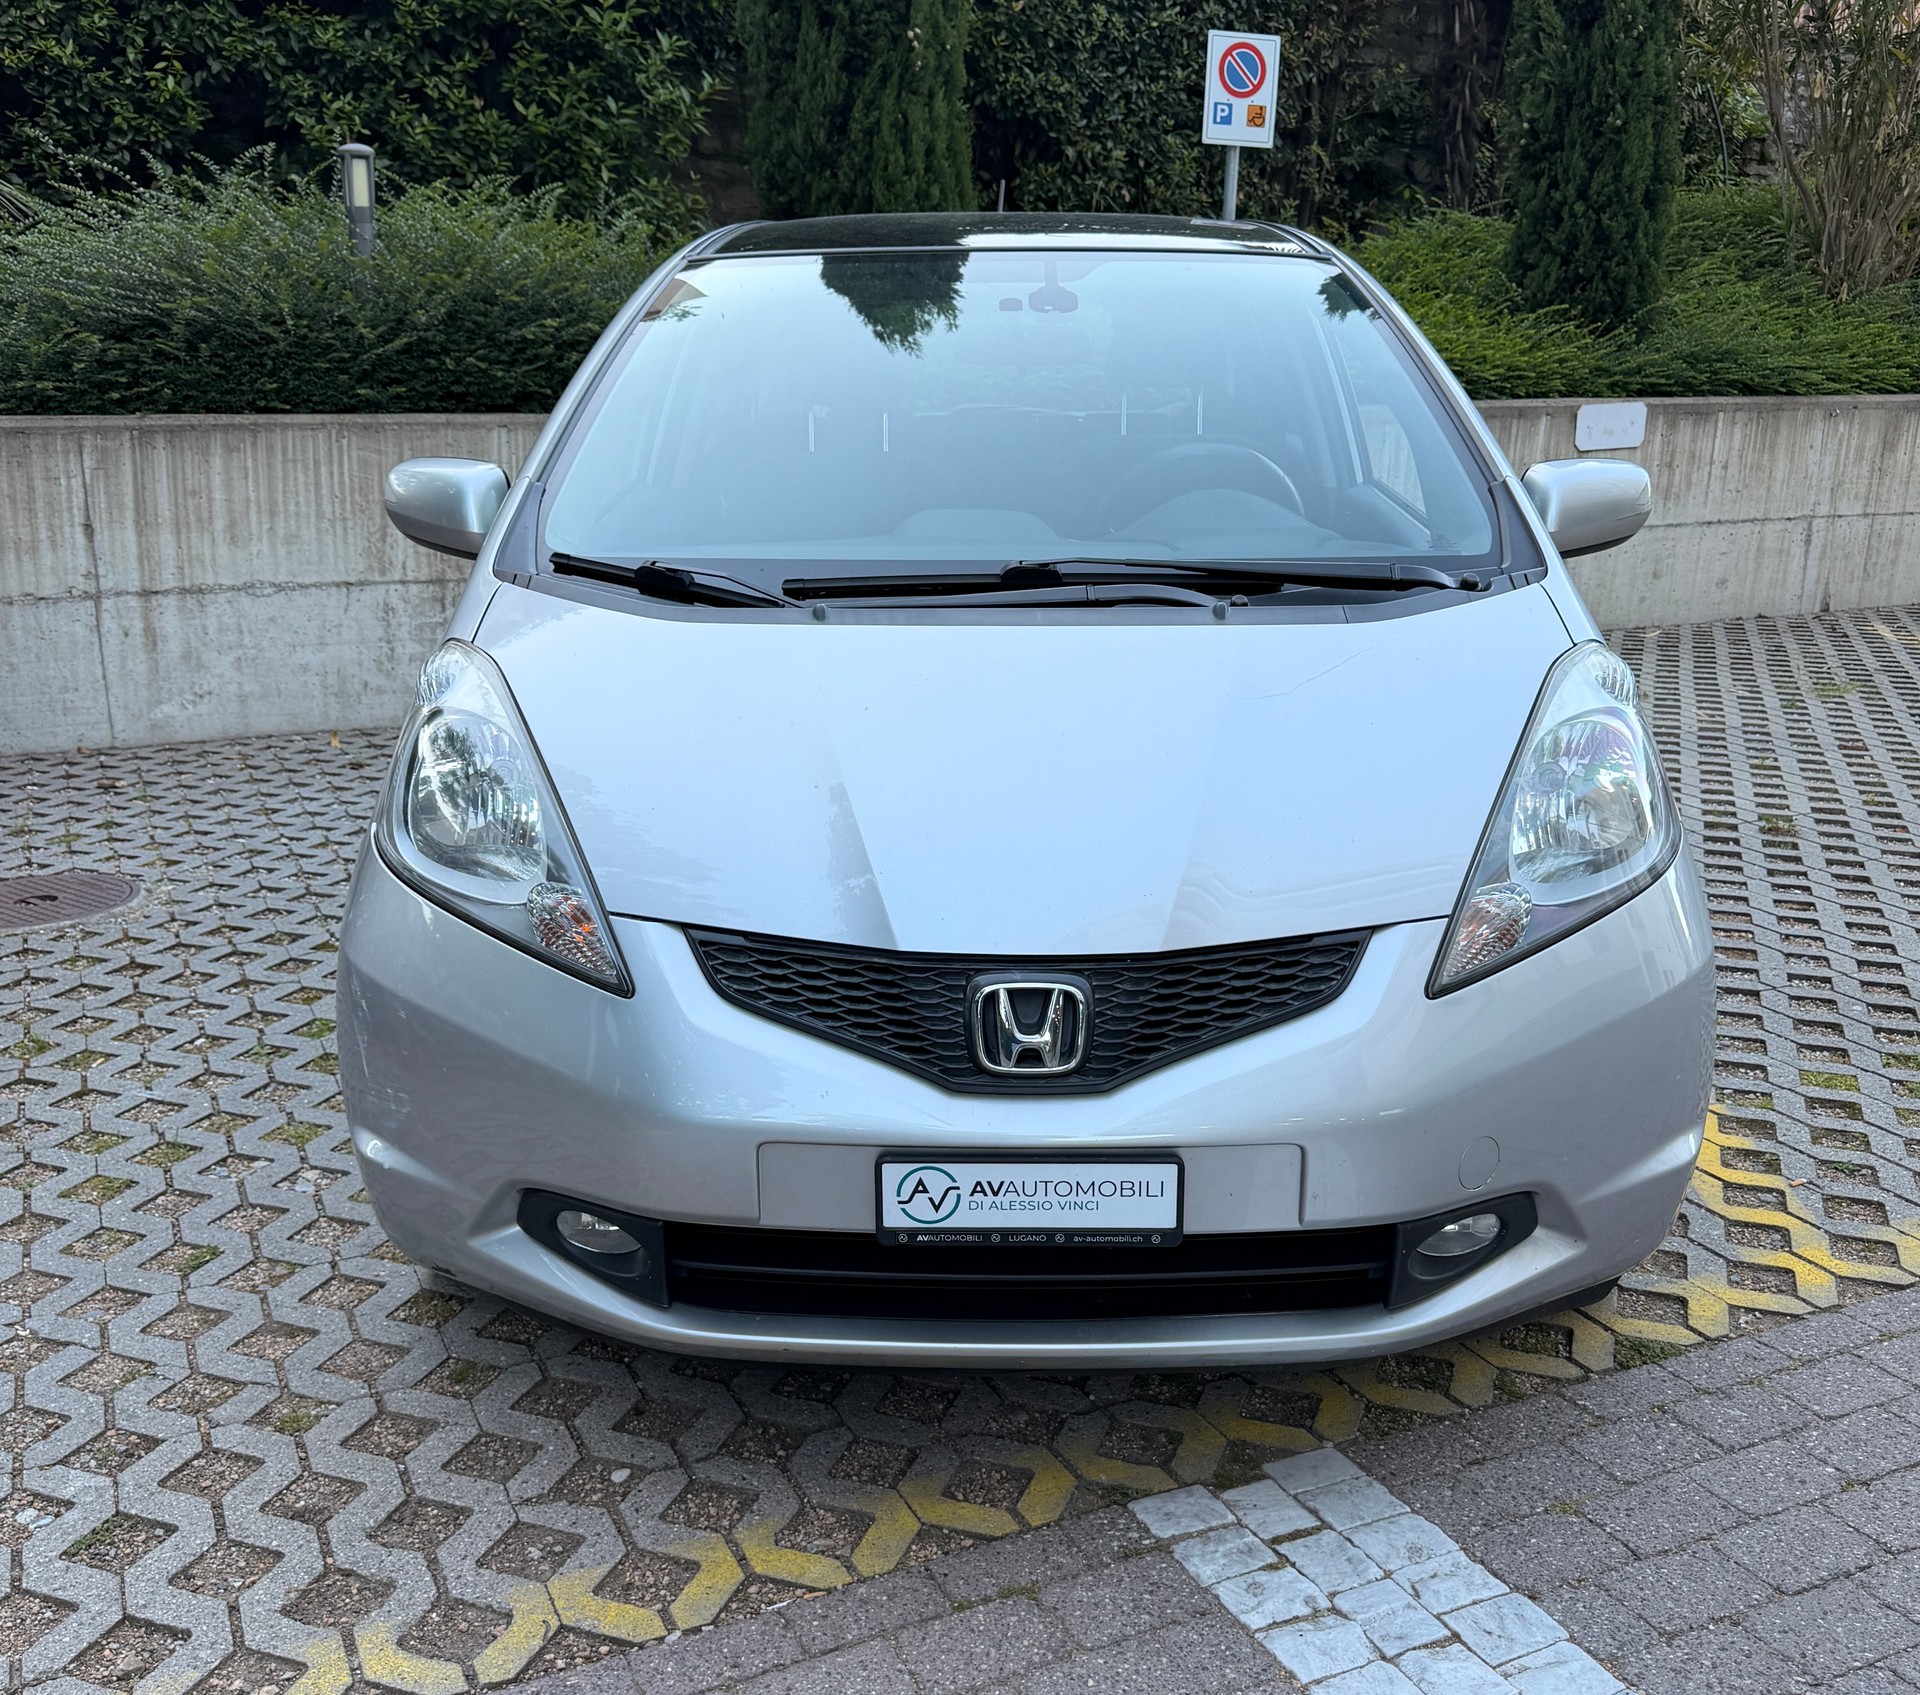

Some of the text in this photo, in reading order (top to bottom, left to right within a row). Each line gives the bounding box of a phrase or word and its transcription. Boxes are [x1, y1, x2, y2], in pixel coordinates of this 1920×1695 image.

[1216, 104, 1230, 123] P
[969, 1180, 1165, 1198] AVAUTOMOBILI
[968, 1200, 1100, 1211] DI ALESSIO VINCI
[916, 1234, 983, 1242] AVAUTOMOBILI
[1008, 1234, 1047, 1242] LUGANO
[1073, 1234, 1143, 1243] av-automobili.ch
